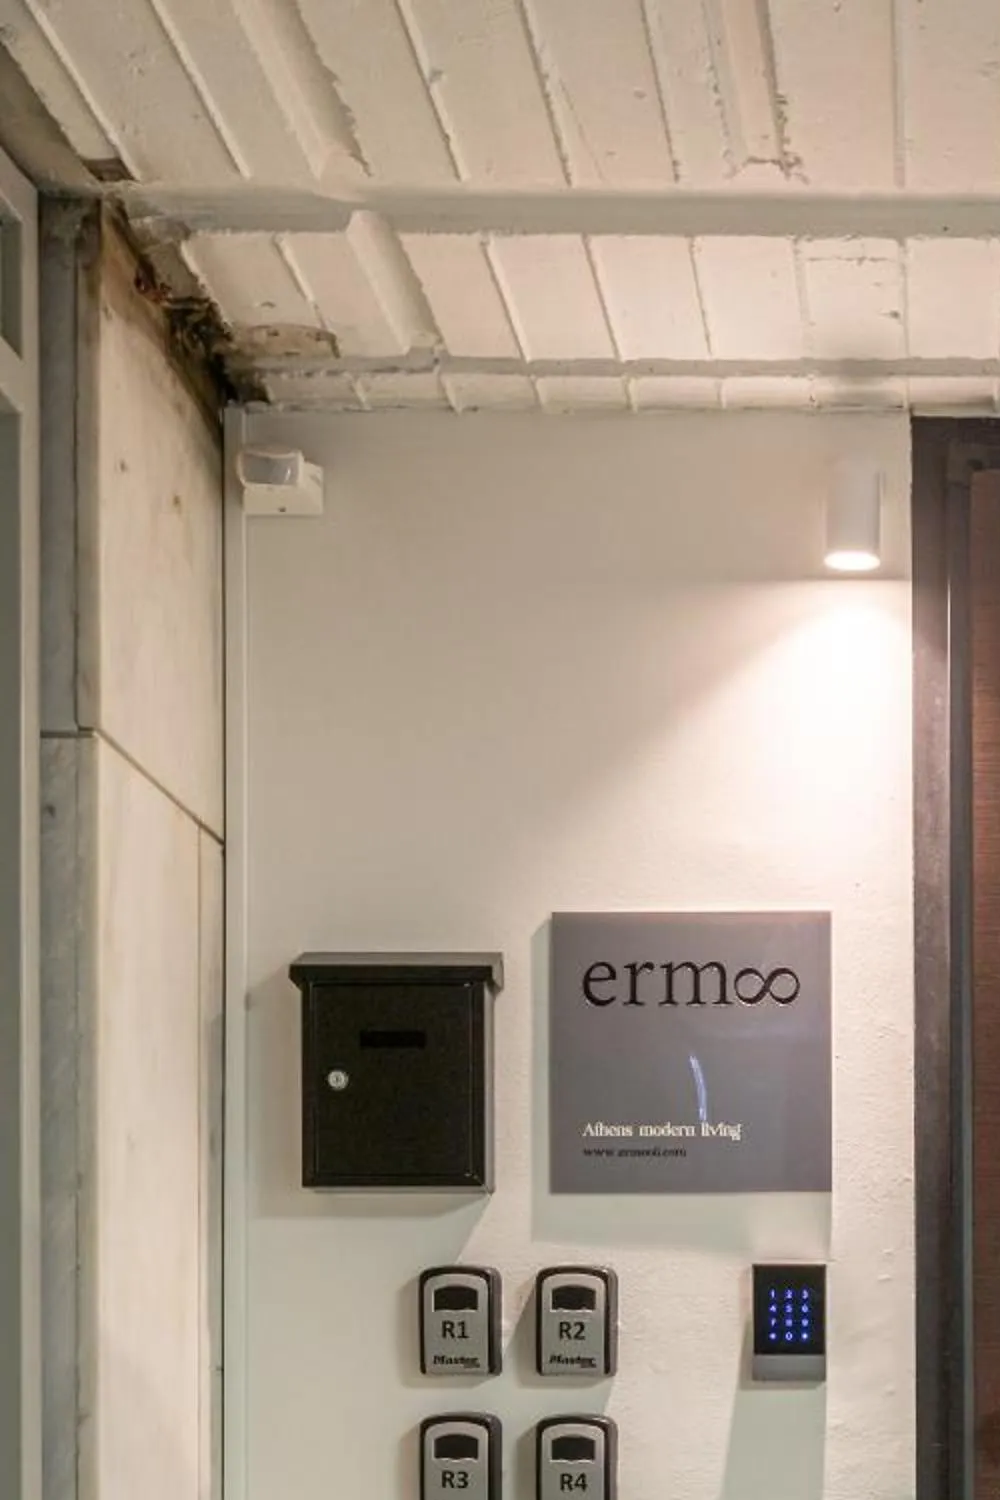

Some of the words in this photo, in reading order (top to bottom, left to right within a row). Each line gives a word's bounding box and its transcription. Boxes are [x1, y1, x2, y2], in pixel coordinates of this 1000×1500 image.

[582, 1121, 634, 1137] Athens
[639, 1121, 695, 1137] modern
[701, 1121, 742, 1141] living
[441, 1320, 470, 1339] R1
[558, 1321, 586, 1341] R2
[441, 1469, 469, 1489] R3
[559, 1472, 588, 1492] R4
